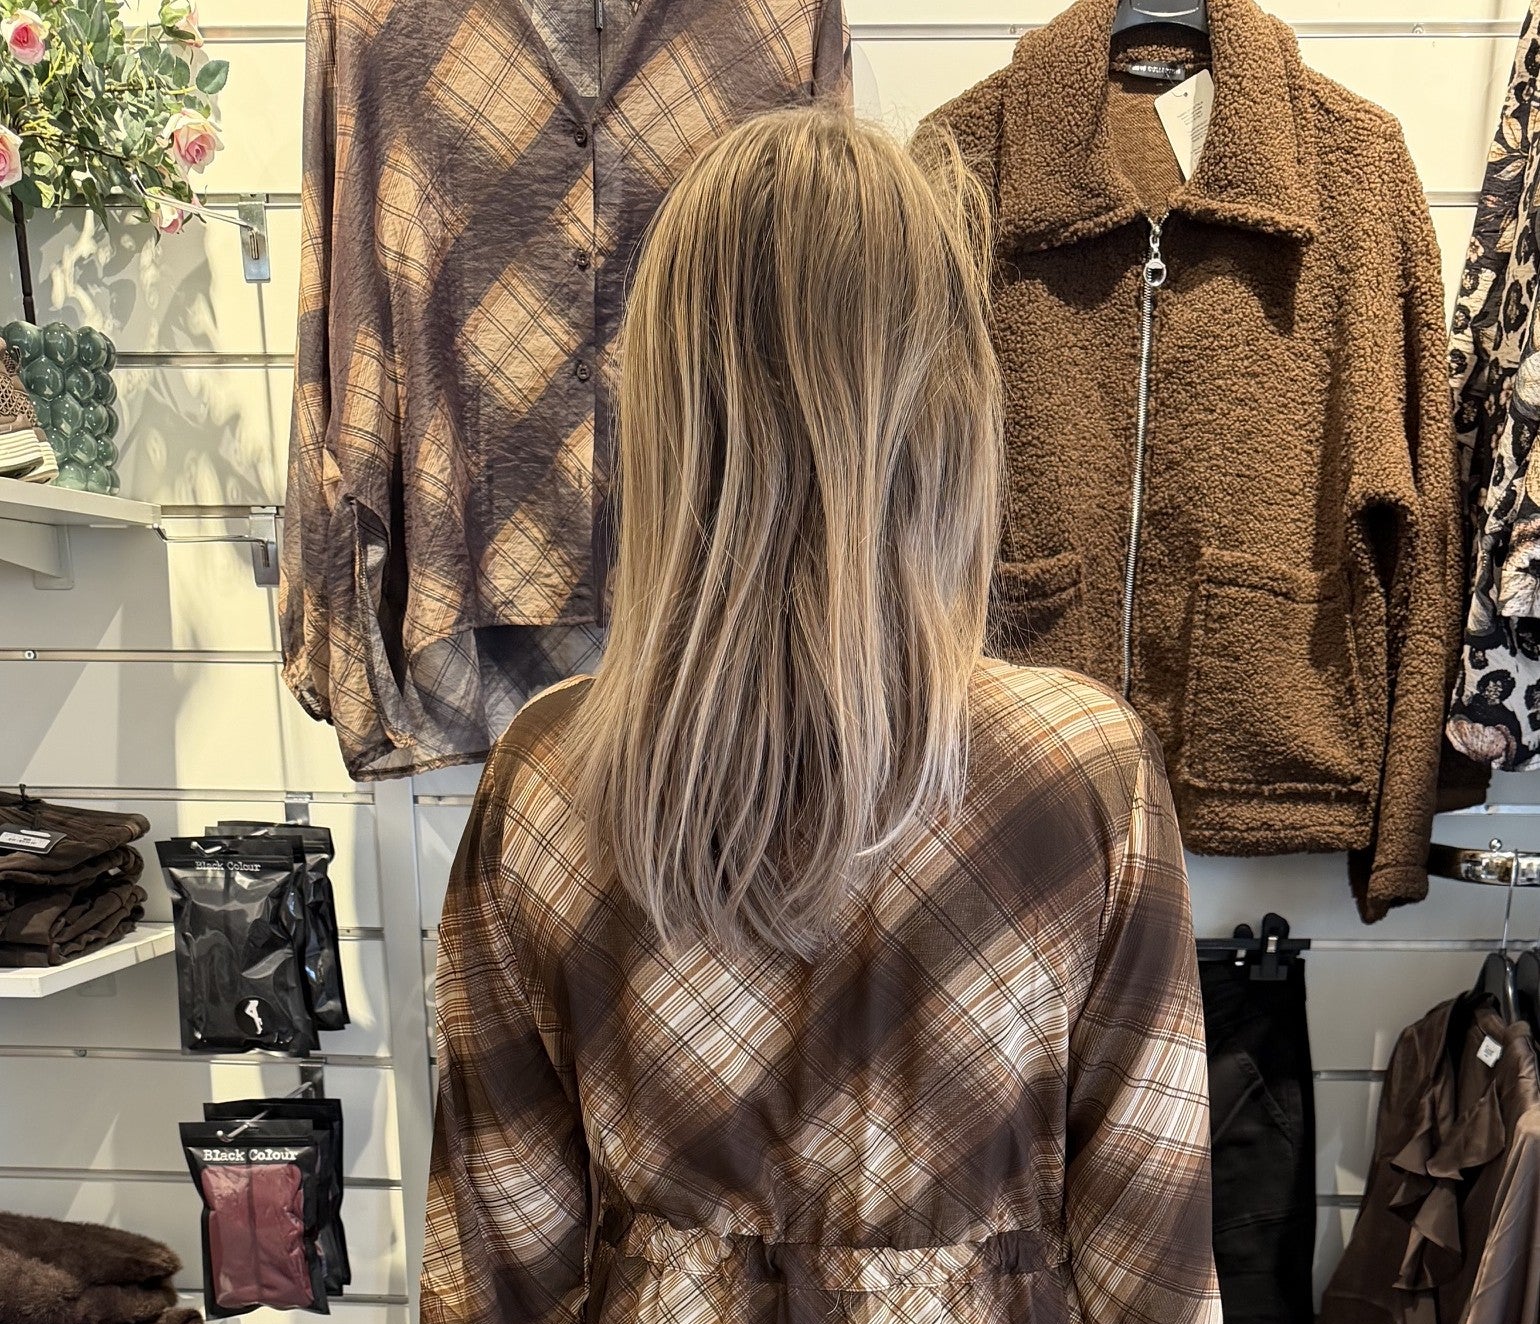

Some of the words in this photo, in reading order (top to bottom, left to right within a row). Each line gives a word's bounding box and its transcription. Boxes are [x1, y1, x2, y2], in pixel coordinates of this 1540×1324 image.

[195, 861, 225, 871] Black
[227, 861, 261, 872] Colour
[202, 1148, 245, 1161] Black
[248, 1148, 298, 1161] Colour
